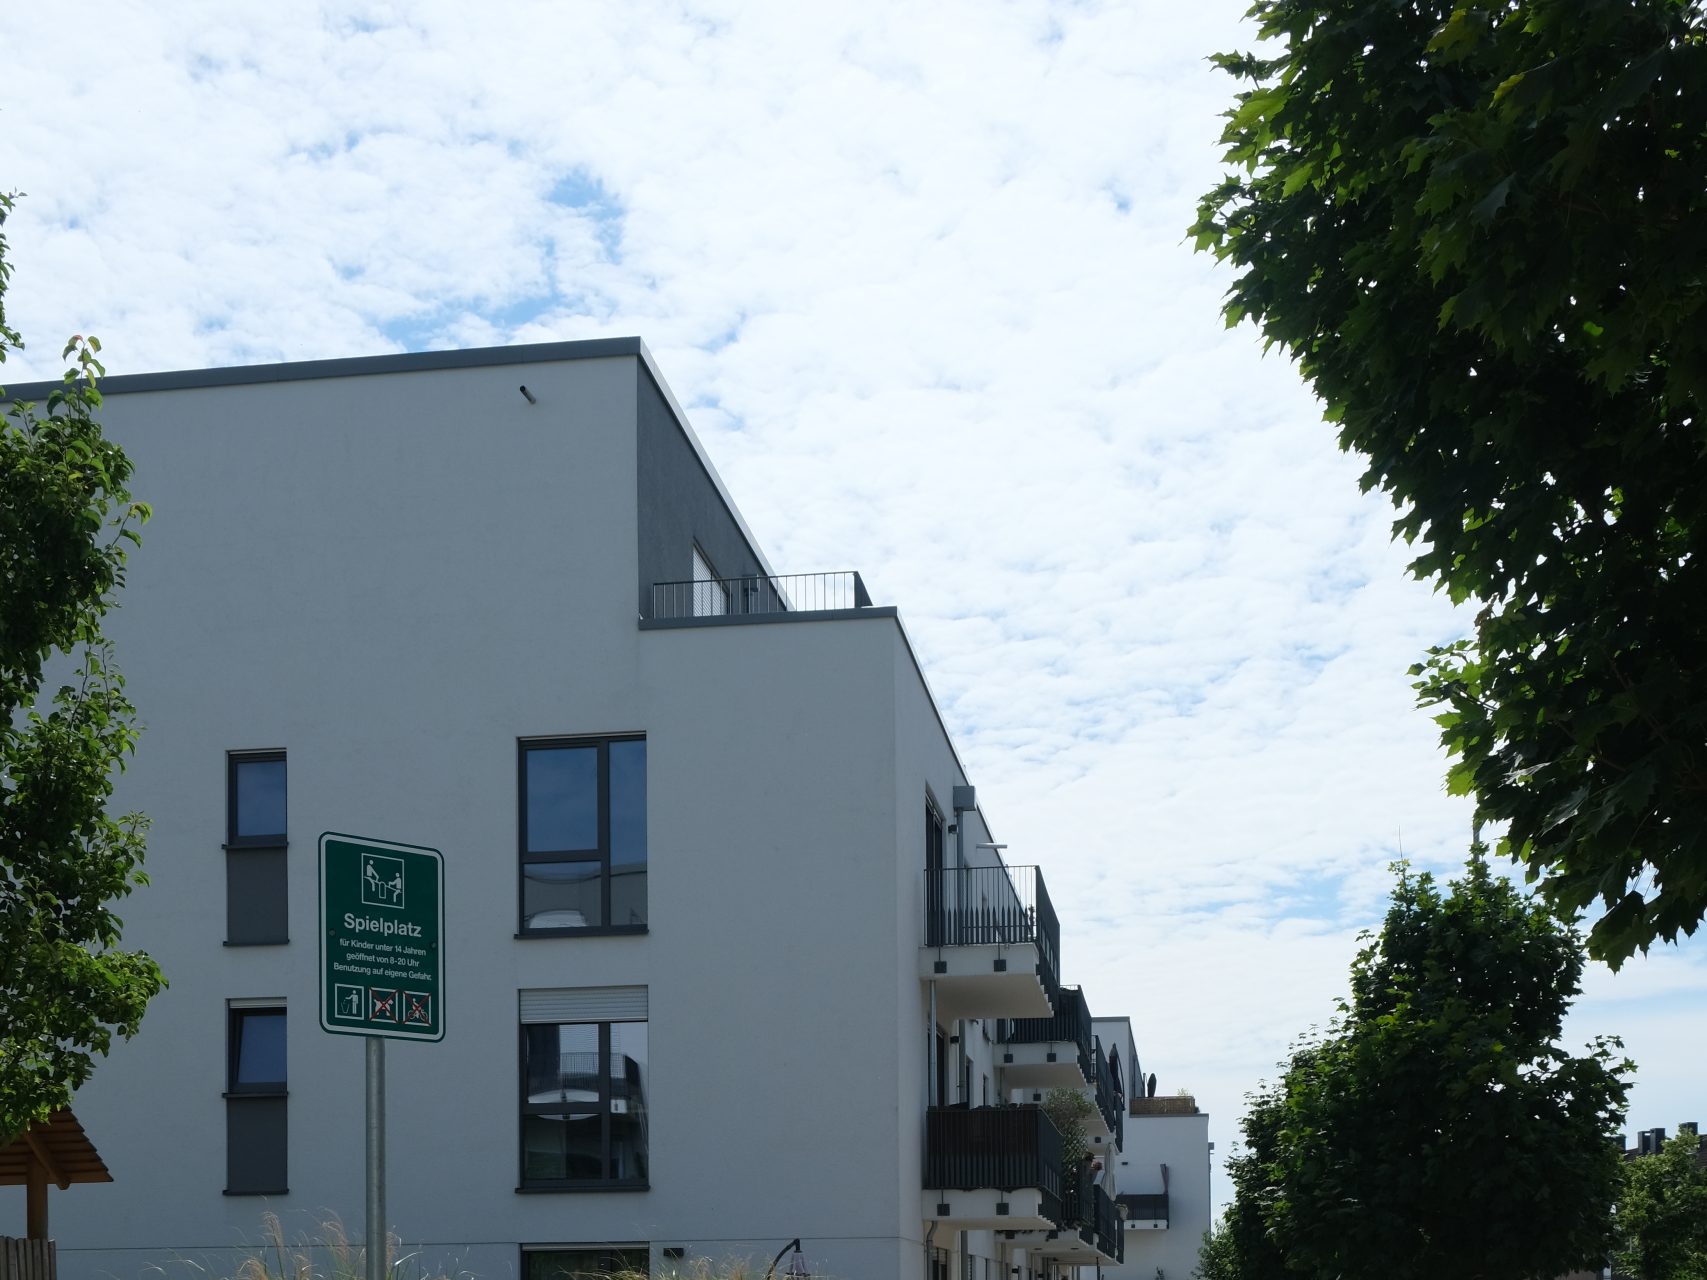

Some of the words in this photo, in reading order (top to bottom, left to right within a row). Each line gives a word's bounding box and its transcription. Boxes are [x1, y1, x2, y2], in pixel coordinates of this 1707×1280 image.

[344, 912, 422, 937] Spielplatz
[339, 938, 350, 947] für
[350, 939, 375, 949] Kinder
[375, 944, 393, 952] unter
[395, 945, 402, 953] 14
[403, 946, 426, 956] Jahren
[346, 952, 375, 962] geöffnet
[407, 958, 419, 967] Uhr
[333, 962, 371, 975] Benutzung
[384, 968, 408, 978] eigene
